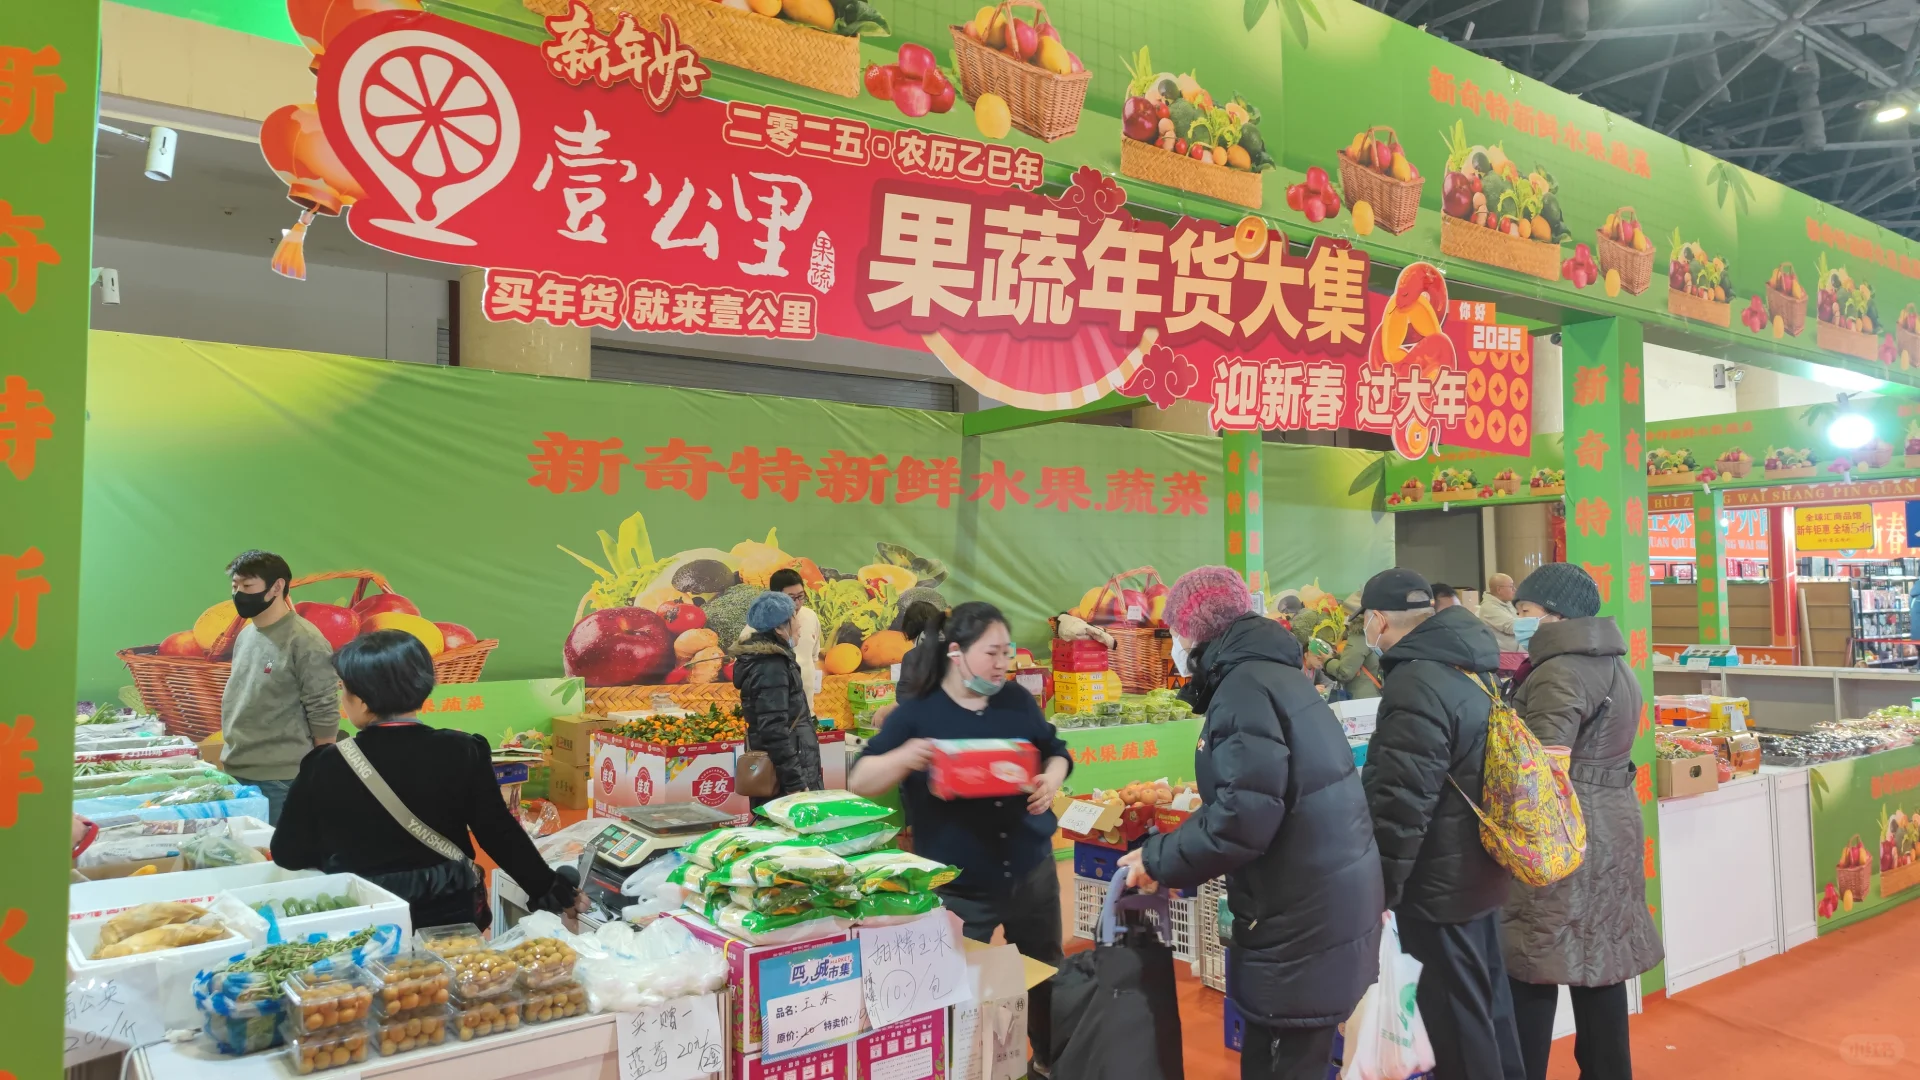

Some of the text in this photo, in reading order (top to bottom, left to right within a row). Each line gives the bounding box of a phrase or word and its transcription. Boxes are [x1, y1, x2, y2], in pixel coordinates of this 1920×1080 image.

[547, 4, 707, 106] 新年好
[533, 110, 813, 278] 壹公里
[810, 235, 834, 290] 果蔬
[868, 192, 1369, 344] 果蔬年货大集
[492, 275, 812, 335] 买年货 就来壹公里
[1459, 302, 1486, 322] 你好
[1472, 325, 1522, 351] 2025
[1213, 360, 1468, 428] 迎新春 过大年
[1654, 498, 1679, 510] HUI
[1738, 492, 1767, 505] WAI
[1772, 487, 1826, 503] SHANG
[1833, 484, 1864, 499] PIN
[1868, 480, 1916, 495] GUAN
[601, 769, 614, 784] 佳农
[637, 778, 650, 795] 佳农
[699, 778, 729, 796] 佳农
